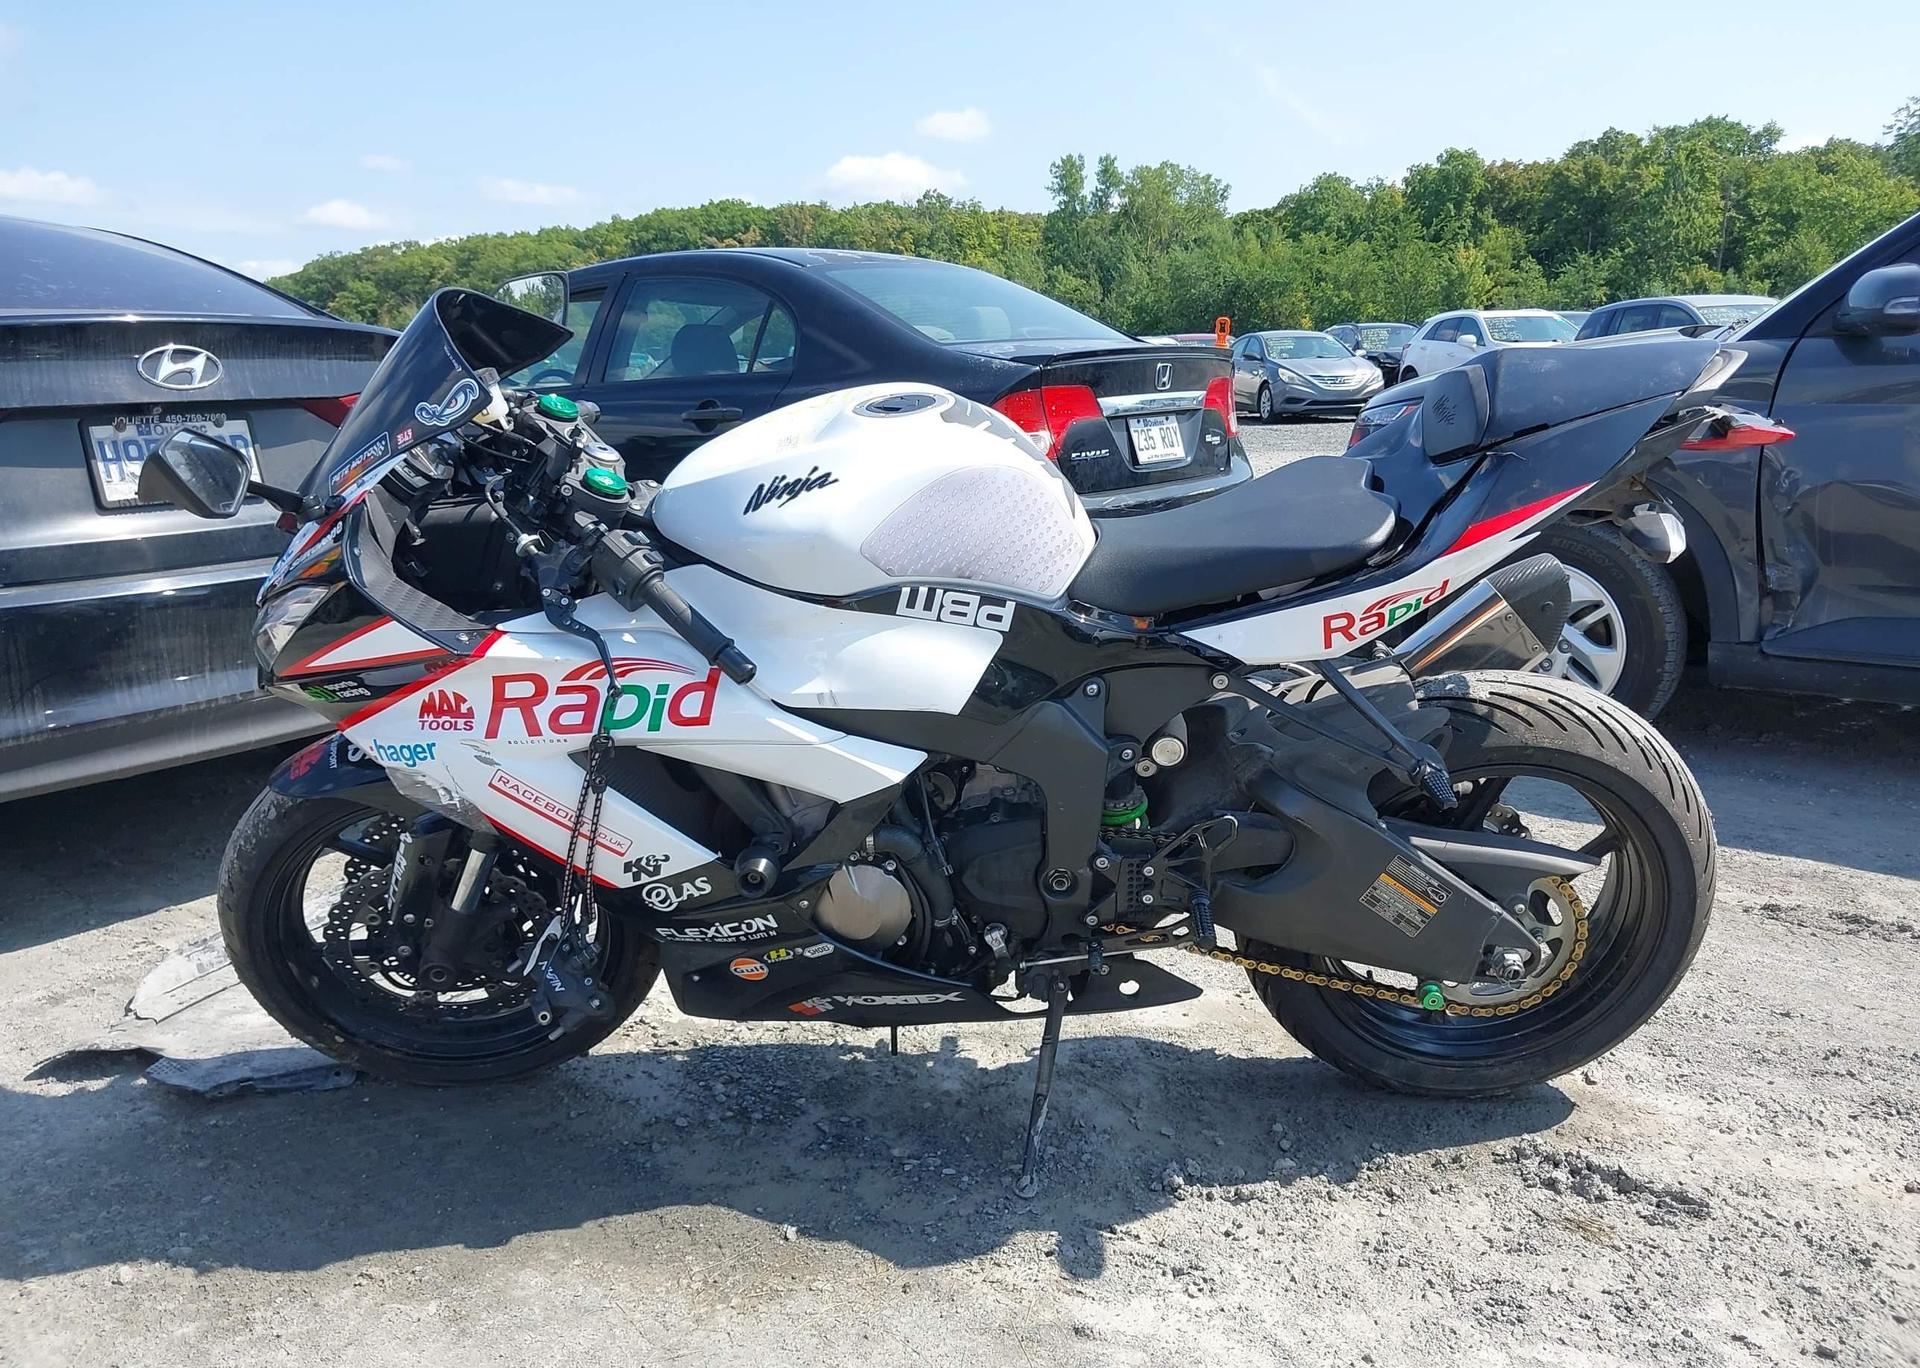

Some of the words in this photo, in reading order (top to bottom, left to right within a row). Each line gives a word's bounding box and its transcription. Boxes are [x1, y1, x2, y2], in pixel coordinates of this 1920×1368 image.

[743, 466, 839, 516] Ninja
[1322, 579, 1450, 650] Rapid
[336, 687, 371, 699] racing
[418, 689, 475, 720] MAC
[484, 665, 722, 740] Rapid
[418, 719, 474, 731] TOOLS
[373, 738, 436, 768] hager
[808, 944, 830, 956] SHOEI
[734, 964, 765, 974] Gulf
[832, 991, 966, 1007] VORTEX
